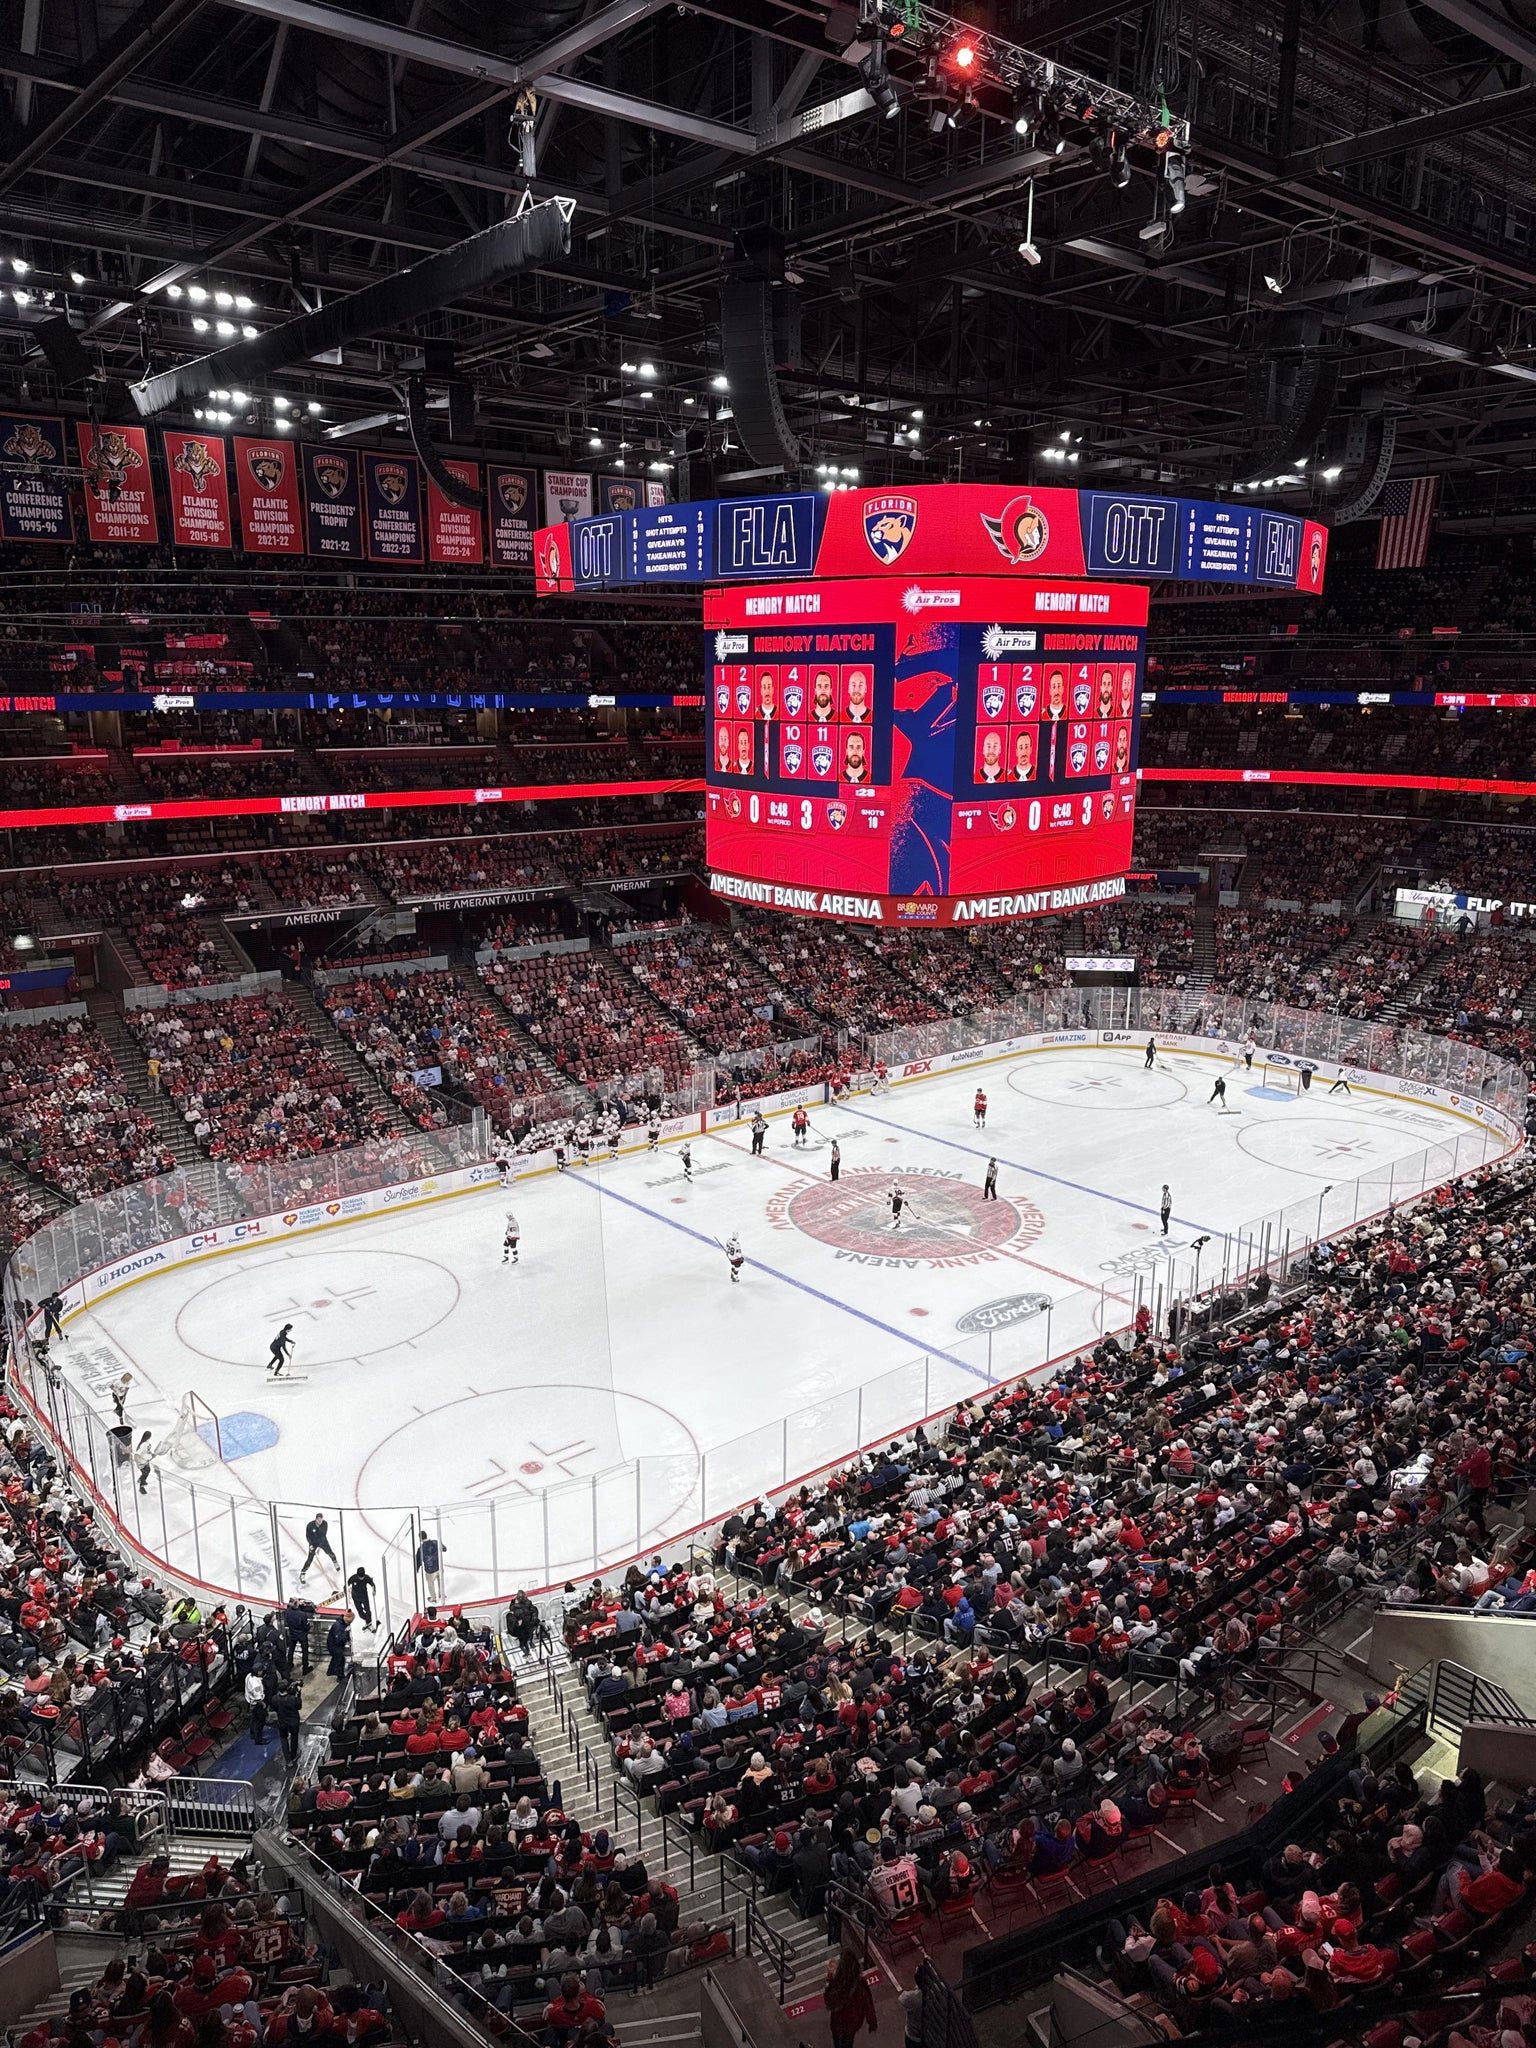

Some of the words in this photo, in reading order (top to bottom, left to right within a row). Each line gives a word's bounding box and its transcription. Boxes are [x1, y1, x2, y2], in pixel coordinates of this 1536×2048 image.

[548, 475, 574, 486] STANLEY
[576, 478, 588, 487] CUP
[550, 487, 587, 497] CHAMPIONS
[6, 492, 63, 507] CONFERENCE
[182, 495, 218, 509] ATLANTIC
[252, 497, 288, 510] ATLANTIC
[868, 501, 912, 511] FLORIDA
[9, 506, 63, 520] CHAMPIONS
[101, 502, 141, 513] DIVISION
[184, 506, 218, 519] DIVISION
[310, 502, 356, 516] PRESIDENTS'
[95, 513, 149, 525] CHAMPIONS
[254, 510, 289, 522] DIVISION
[379, 509, 409, 520] EASTERN
[440, 513, 471, 524] ATLANTIC
[658, 515, 673, 523] HITS
[1216, 513, 1230, 522] HITS
[19, 520, 57, 533] 1995-96
[179, 518, 225, 530] CHAMPIONS
[249, 522, 295, 534] CHAMPIONS
[320, 515, 348, 528] TROPHY
[373, 520, 416, 532] CONFERENCE
[501, 518, 528, 529] EASTERN
[108, 526, 140, 538] 2011-12
[441, 524, 470, 534] DIVISION
[495, 528, 533, 540] CONFERENCE
[646, 528, 659, 537] SHOT
[659, 526, 687, 536] ATTEMPTS
[1105, 503, 1165, 564] OTT
[190, 531, 219, 542] 2015-16
[258, 534, 289, 546] 2021-22
[375, 531, 416, 543] CHAMPIONS
[436, 535, 476, 546] CHAMPIONS
[733, 505, 797, 567] FLA
[1204, 537, 1237, 548] GIVEAWAYS
[321, 539, 350, 551] 2021-22
[382, 543, 411, 554] 2022-23
[497, 539, 533, 551] CHAMPIONS
[581, 523, 613, 578] OTT
[648, 539, 685, 549] GIVEAWAYS
[1266, 521, 1295, 577] FLA
[442, 546, 470, 557] 2023-24
[503, 551, 528, 561] 2023-24
[647, 551, 686, 560] TAKEAWAYS
[1203, 549, 1237, 559] TAKEAWAYS
[646, 564, 668, 572] BLOCKED
[669, 563, 687, 571] SHOTS
[745, 596, 783, 616] MEMORY
[785, 594, 821, 614] MATCH
[915, 596, 930, 604] Air
[933, 596, 955, 604] Pros
[1035, 592, 1077, 612] MEMORY
[1079, 594, 1110, 613] MATCH
[722, 642, 731, 650] Air
[731, 641, 745, 650] Pros
[754, 634, 814, 653] MEMORY
[815, 633, 875, 652] MATCH
[996, 638, 1010, 647] Air
[1012, 638, 1032, 647] Pros
[1044, 633, 1102, 651] MEMORY
[1103, 635, 1139, 651] MATCH
[720, 668, 725, 681] 1
[739, 667, 747, 681] 2
[788, 667, 799, 681] 4
[992, 667, 998, 681] 1
[1022, 666, 1032, 681] 2
[1078, 666, 1088, 680] 4
[14, 697, 56, 711] MATCH
[673, 695, 701, 706] MEMORY
[1223, 692, 1258, 703] MEMORY
[1259, 692, 1288, 703] MATCH
[785, 726, 800, 740] 10
[817, 728, 828, 742] 11
[1073, 724, 1087, 739] 10
[1100, 723, 1108, 737] 11
[855, 788, 875, 797] :28
[280, 795, 326, 812] MEMORY
[329, 793, 365, 810] MATCH
[750, 794, 760, 823] 0
[770, 801, 788, 818] 6:48
[801, 799, 812, 830] 3
[861, 809, 885, 817] SHOTS
[958, 810, 981, 818] SHOTS
[1028, 801, 1041, 831] 0
[1053, 802, 1072, 819] 6:48
[1082, 796, 1092, 826] 3
[867, 817, 879, 829] 10
[966, 817, 973, 830] 6
[610, 880, 651, 893] AMERANT
[432, 900, 451, 912] THE
[453, 895, 501, 910] AMERANT
[502, 892, 536, 904] VAULT
[710, 873, 775, 904] AMERANT
[775, 887, 818, 912] BANK
[819, 894, 884, 920] ARENA
[952, 891, 1050, 922] AMERANT
[1050, 884, 1089, 910] BANK
[1089, 877, 1126, 903] ARENA
[285, 911, 341, 927] AMERANT
[43, 941, 56, 949] 132
[87, 936, 100, 944] 133
[1054, 1034, 1087, 1043] AMAZING
[1155, 1033, 1187, 1042] AMERANT
[951, 1049, 984, 1062] AutoNation
[1269, 1055, 1288, 1064] Ford
[903, 1060, 933, 1077] DEX
[1398, 1080, 1426, 1092] OMEGA
[1423, 1086, 1437, 1097] XL
[780, 1089, 809, 1101] COMCAST
[780, 1096, 809, 1108] BUSINESS
[662, 1121, 685, 1134] Coca-Cola
[383, 1185, 419, 1203] Surfside
[765, 1178, 810, 1231] AMERANT
[890, 1166, 964, 1180] ARENA
[235, 1222, 260, 1237] CH
[1007, 1196, 1046, 1252] AMERANT
[192, 1232, 217, 1248] CH
[834, 1249, 919, 1270] ARENA
[929, 1252, 1000, 1269] BANK
[1099, 1247, 1159, 1271] OMEGA
[109, 1252, 166, 1282] HONDA
[976, 1298, 1036, 1328] Ford
[1003, 1537, 1014, 1552] 19
[886, 1871, 910, 1886] REINHART
[495, 1892, 522, 1901] MARCHAND
[890, 1881, 915, 1909] 13
[252, 1927, 281, 1941] FORSLING
[253, 1935, 283, 1963] 42
[866, 1975, 879, 1986] 121
[790, 2005, 805, 2017] 122
